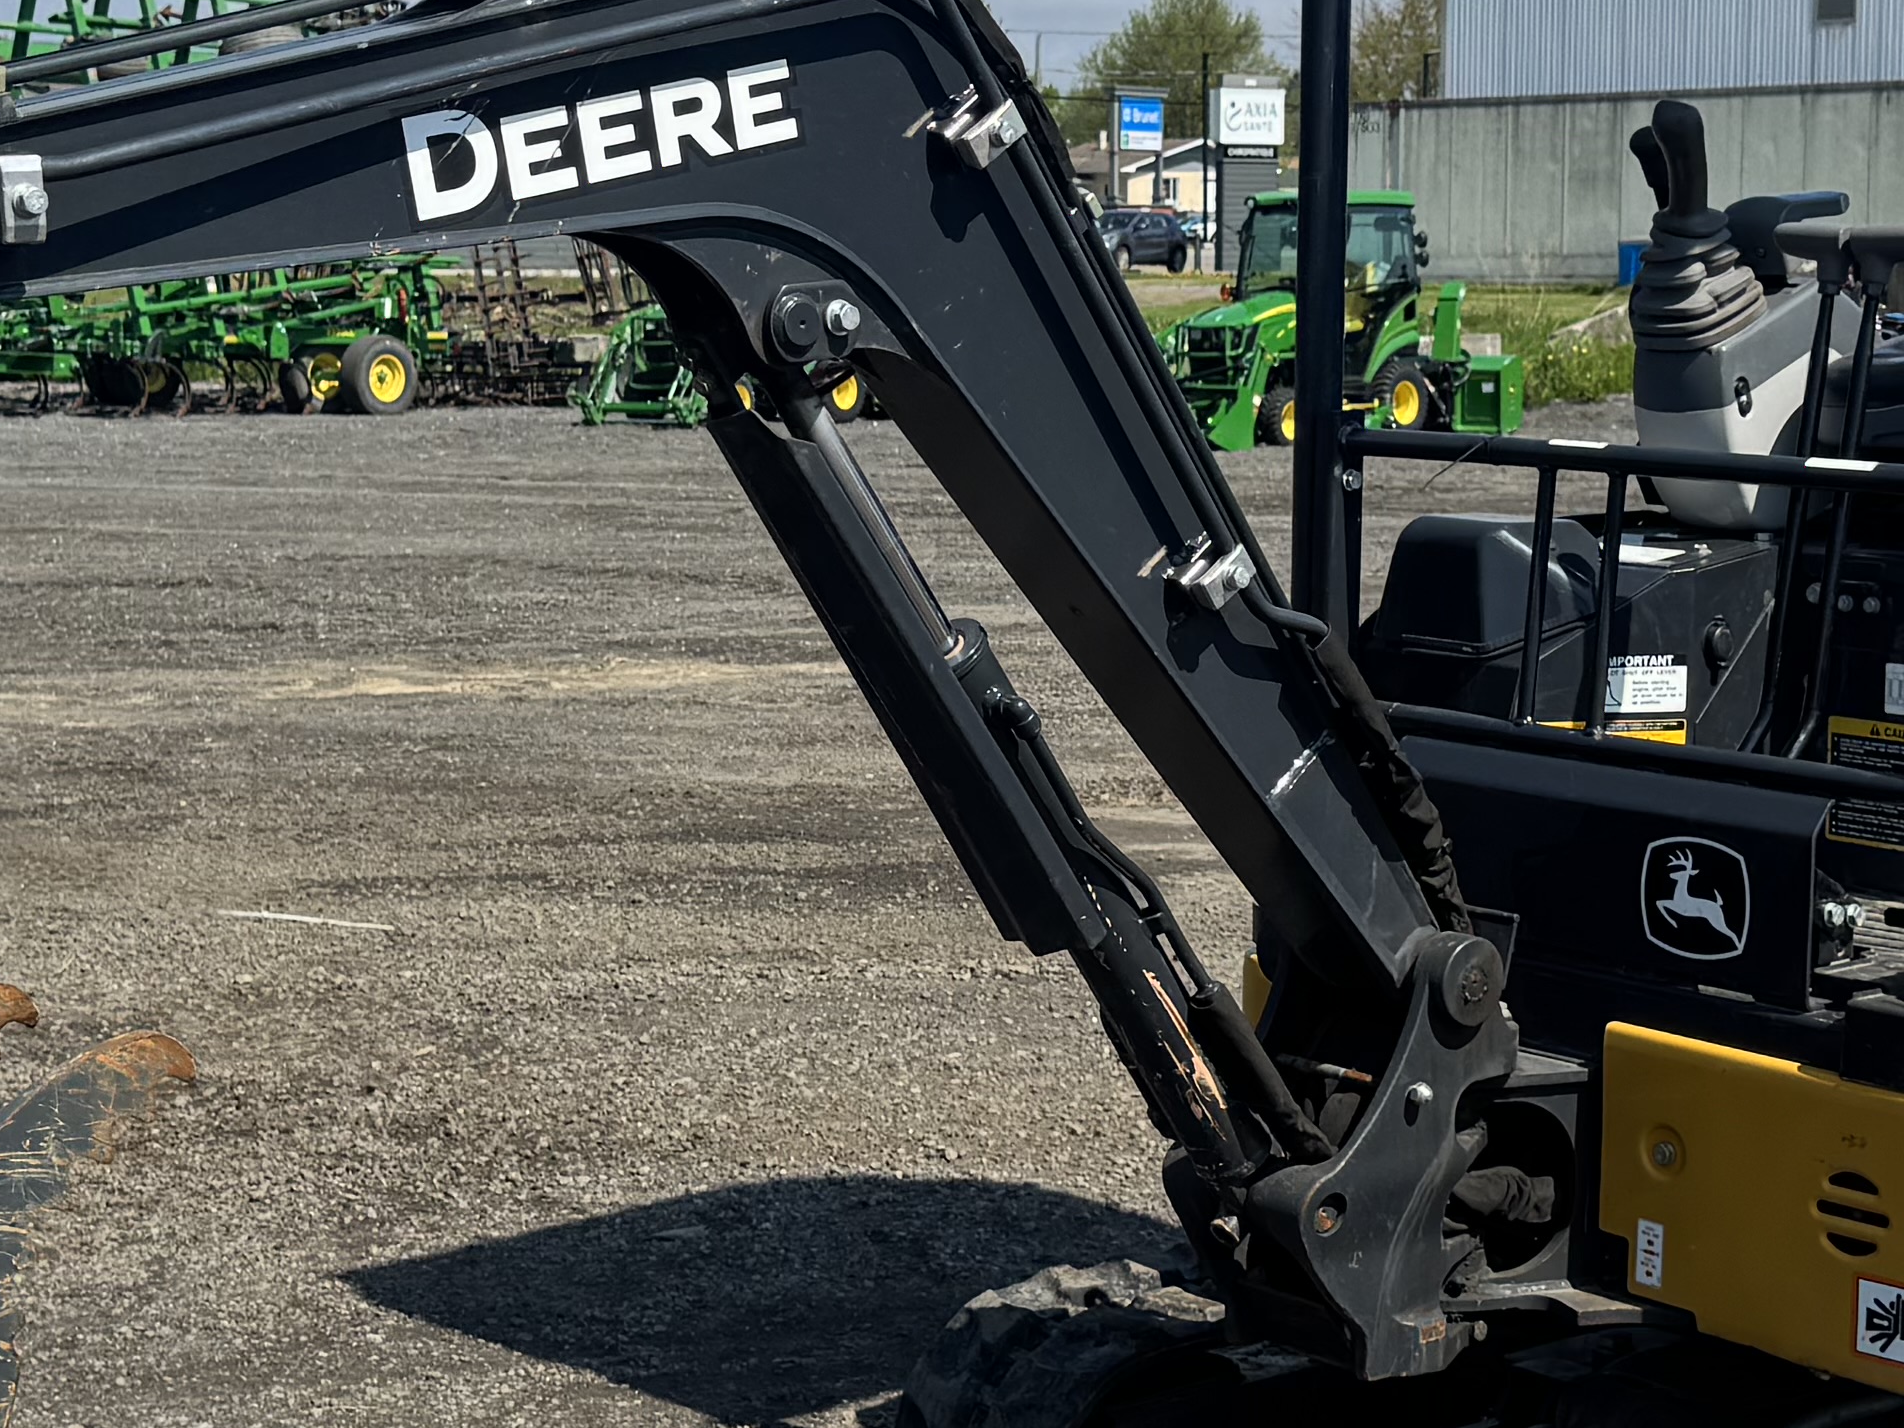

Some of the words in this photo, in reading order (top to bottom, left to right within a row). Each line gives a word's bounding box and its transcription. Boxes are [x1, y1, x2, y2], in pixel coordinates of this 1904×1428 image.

[1244, 102, 1277, 118] AXIA
[401, 58, 799, 222] DEERE
[1608, 654, 1674, 667] MPORTANT
